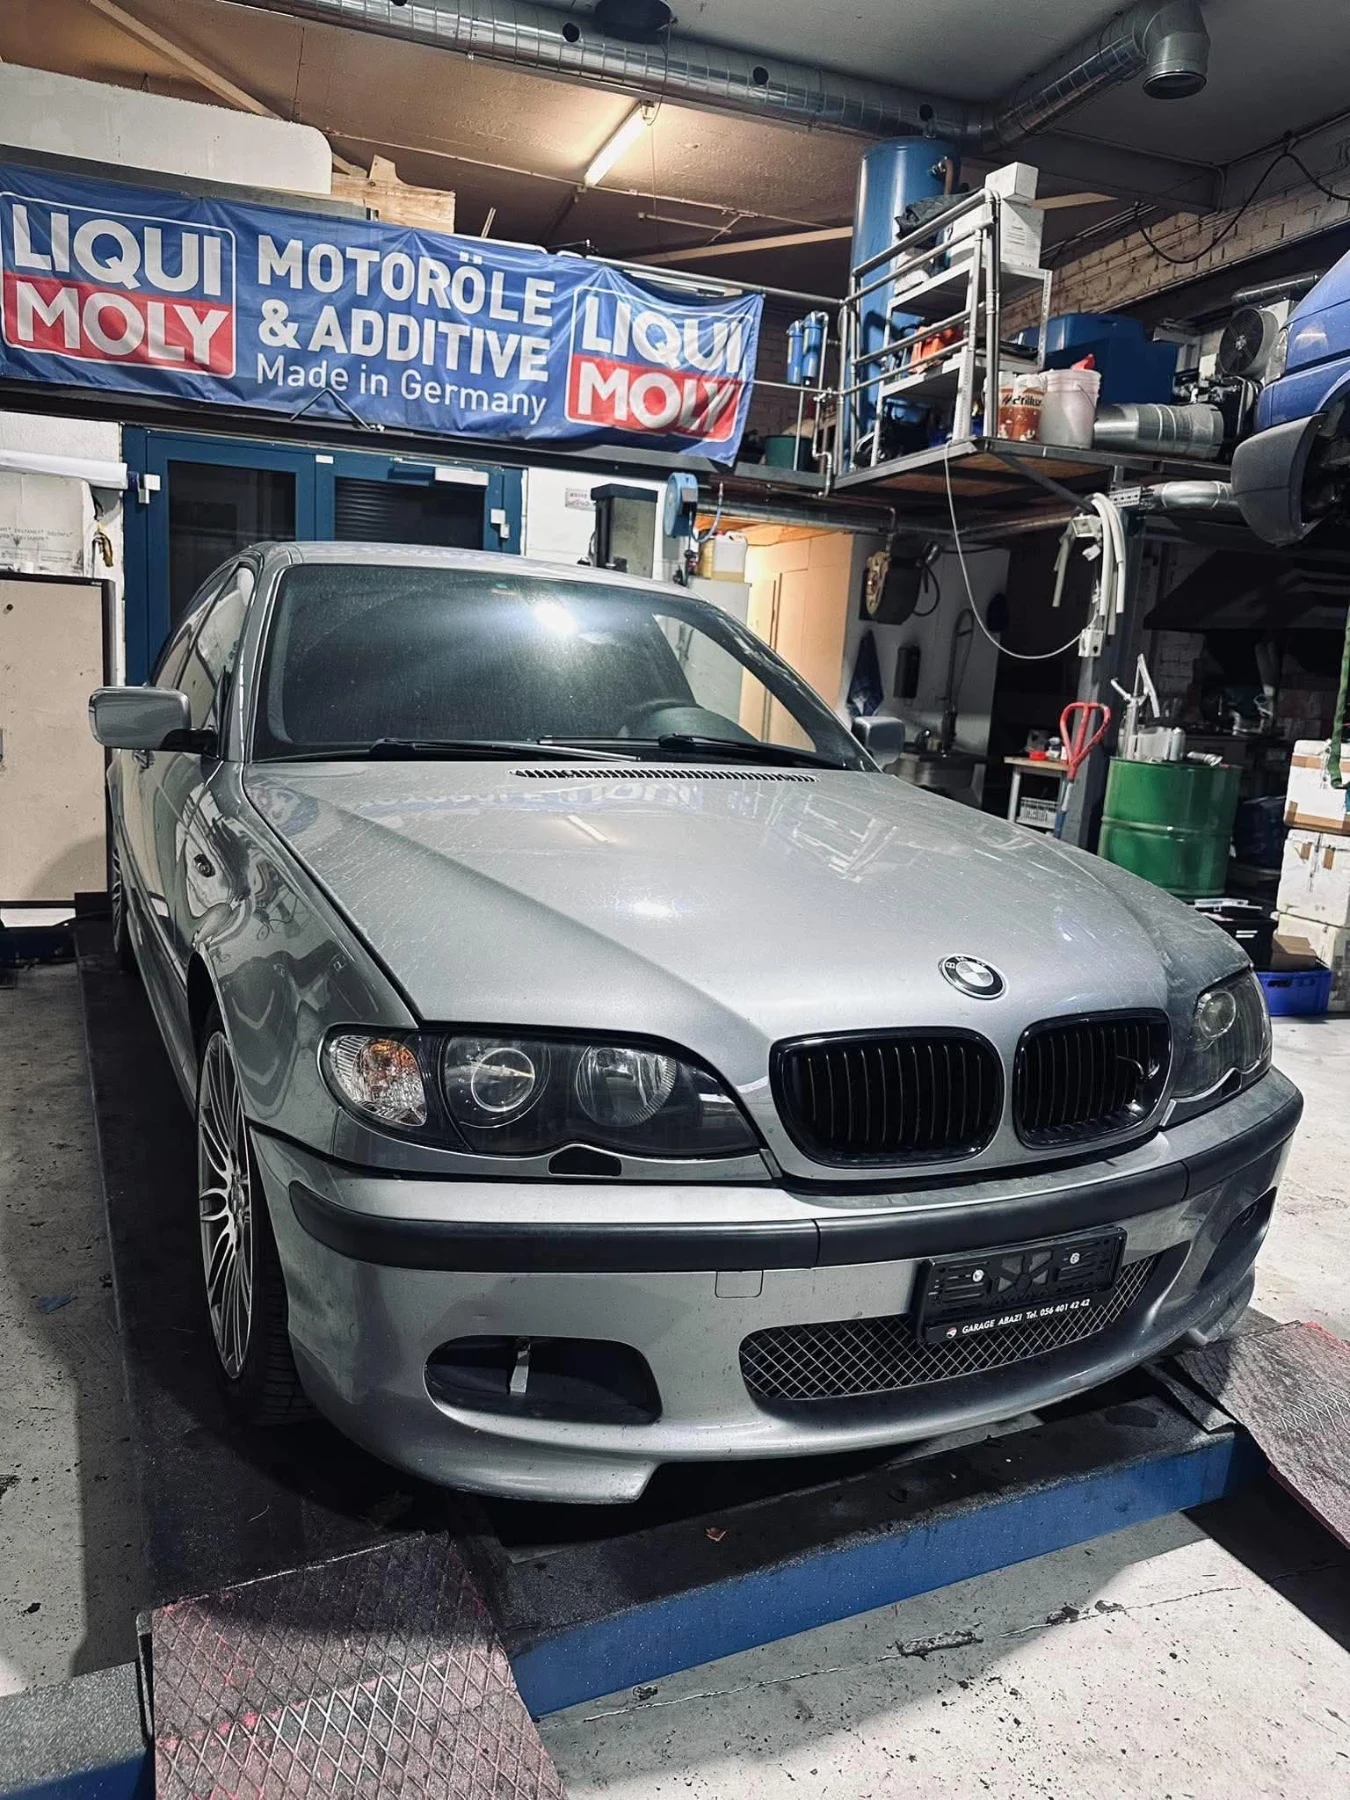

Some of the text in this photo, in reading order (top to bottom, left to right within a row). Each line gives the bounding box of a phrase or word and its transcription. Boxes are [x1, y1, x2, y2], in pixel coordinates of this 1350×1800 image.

[12, 203, 222, 297] LIQUI
[257, 234, 555, 327] MOTORÖLE
[15, 280, 230, 366] MOLY
[258, 298, 549, 383] & ADDITIVE
[581, 297, 743, 373] LIQUI
[257, 353, 547, 426] Made in Germany
[577, 361, 736, 432] MOLY
[962, 1319, 995, 1334] GARAGE
[998, 1313, 1022, 1326] ABAZI
[1040, 1306, 1054, 1317] 056
[1055, 1303, 1069, 1313] 401
[1069, 1300, 1080, 1310] 42
[1080, 1298, 1090, 1307] 42
